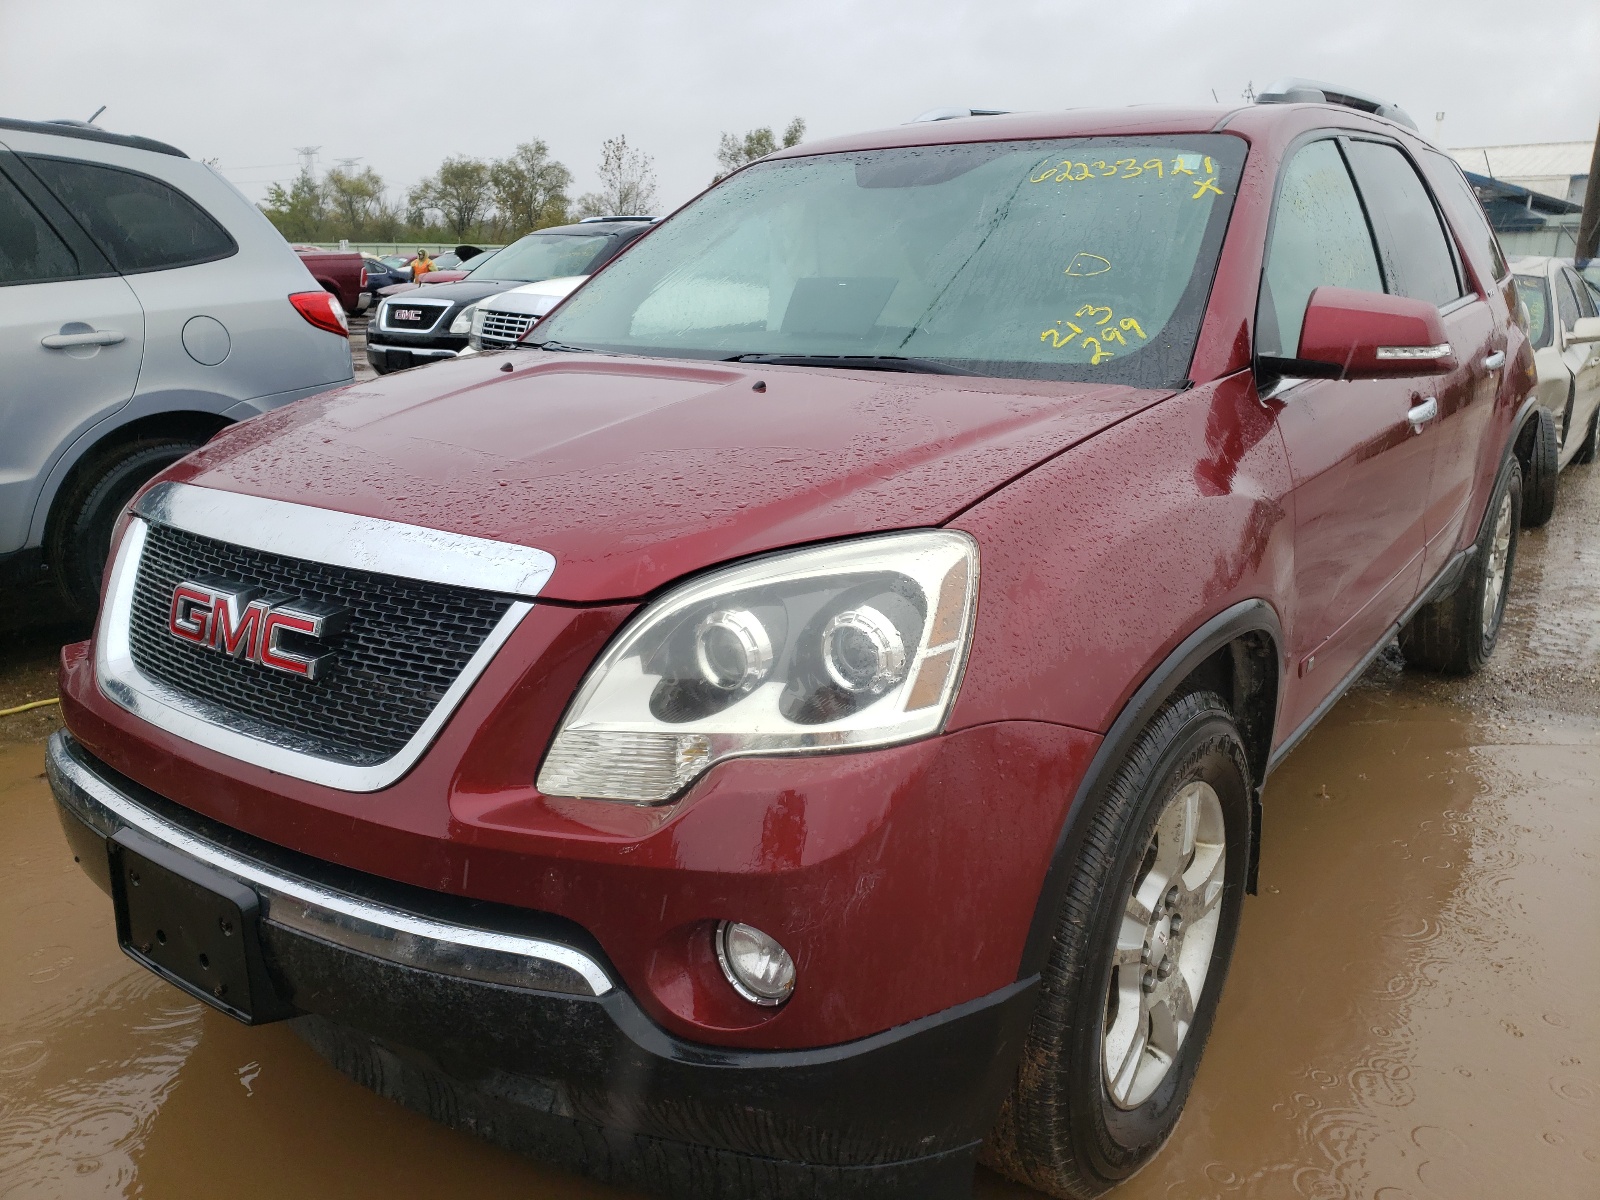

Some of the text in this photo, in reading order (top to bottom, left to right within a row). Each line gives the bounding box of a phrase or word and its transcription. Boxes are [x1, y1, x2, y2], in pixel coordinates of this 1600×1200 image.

[394, 309, 422, 321] GMC
[1081, 317, 1147, 365] 299
[169, 581, 325, 680] GMC
